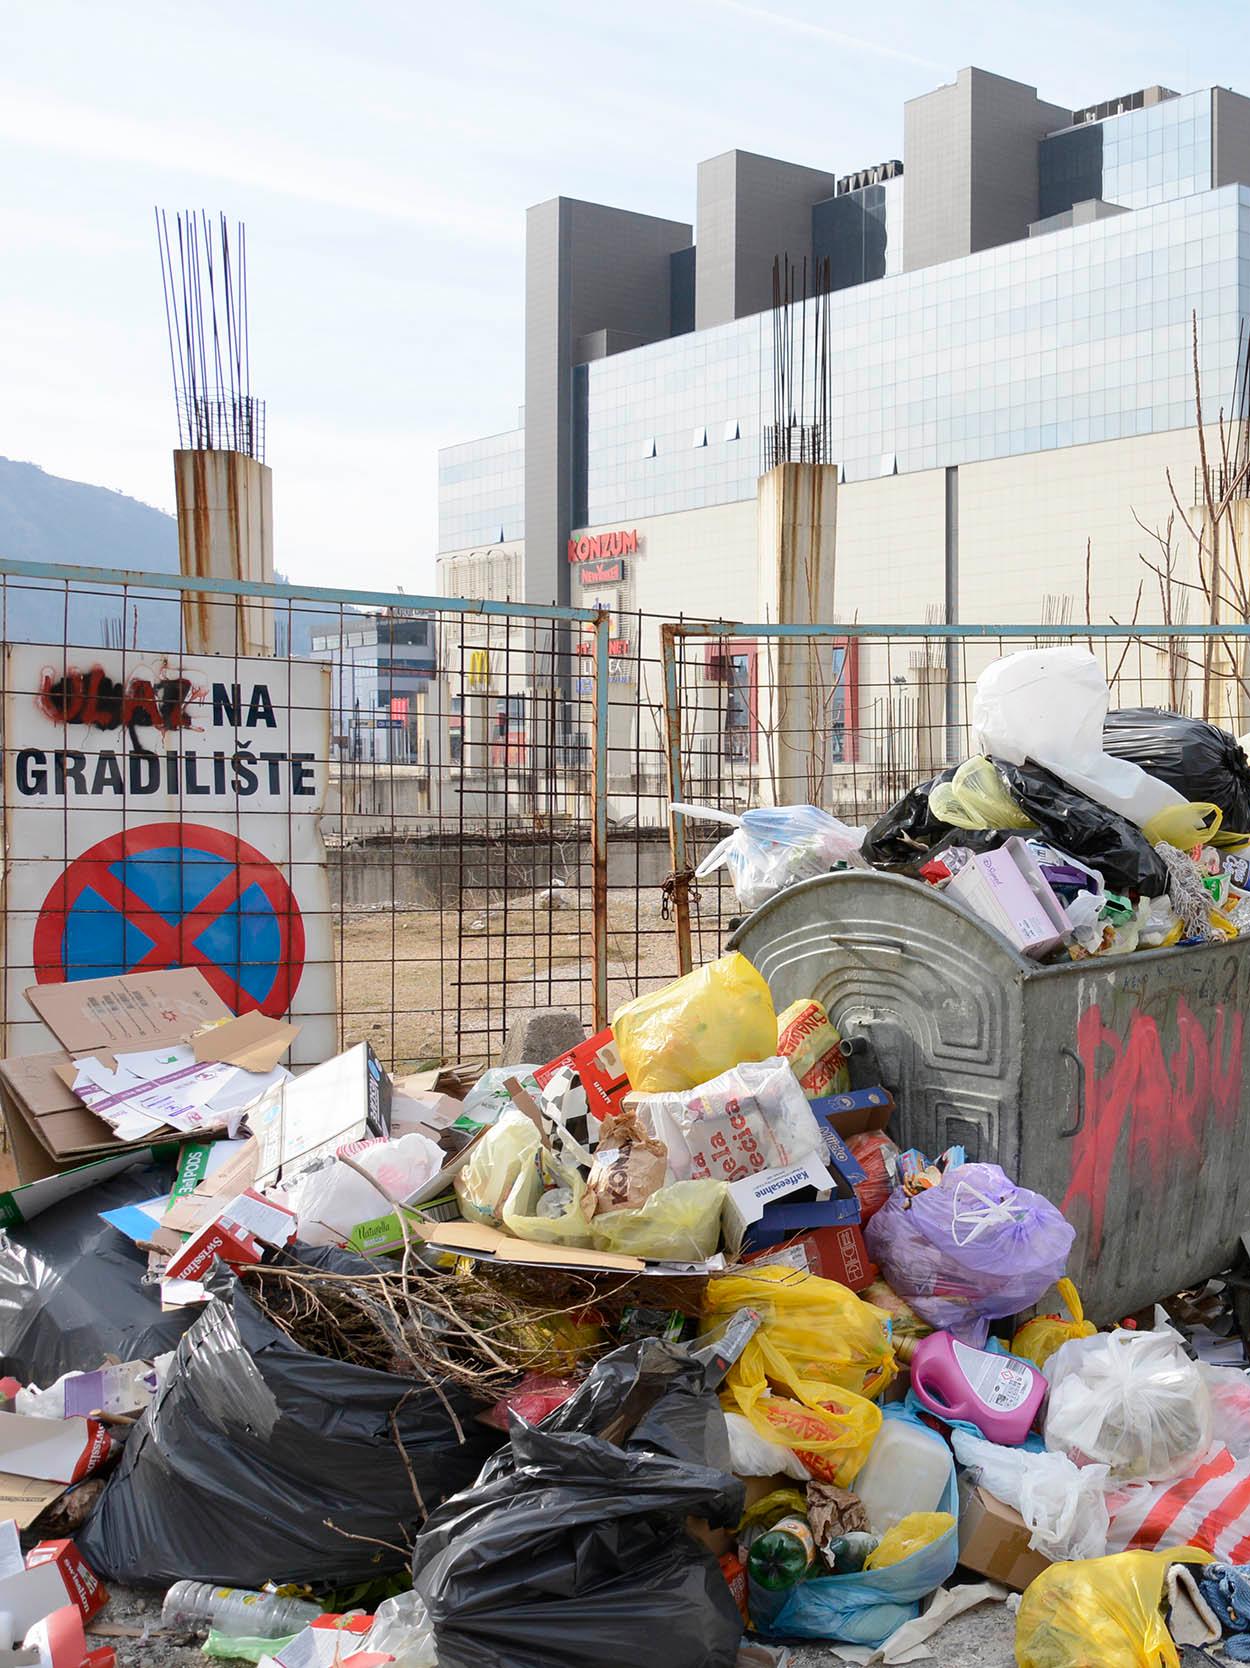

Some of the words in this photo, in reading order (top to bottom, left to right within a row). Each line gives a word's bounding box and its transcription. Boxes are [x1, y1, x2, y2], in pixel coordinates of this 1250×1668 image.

[568, 529, 637, 562] KONZUM
[212, 682, 278, 728] NA
[15, 740, 317, 796] GRADILIŠTE
[755, 1170, 810, 1199] Kaffeesahne
[177, 1236, 223, 1280] Swisslion
